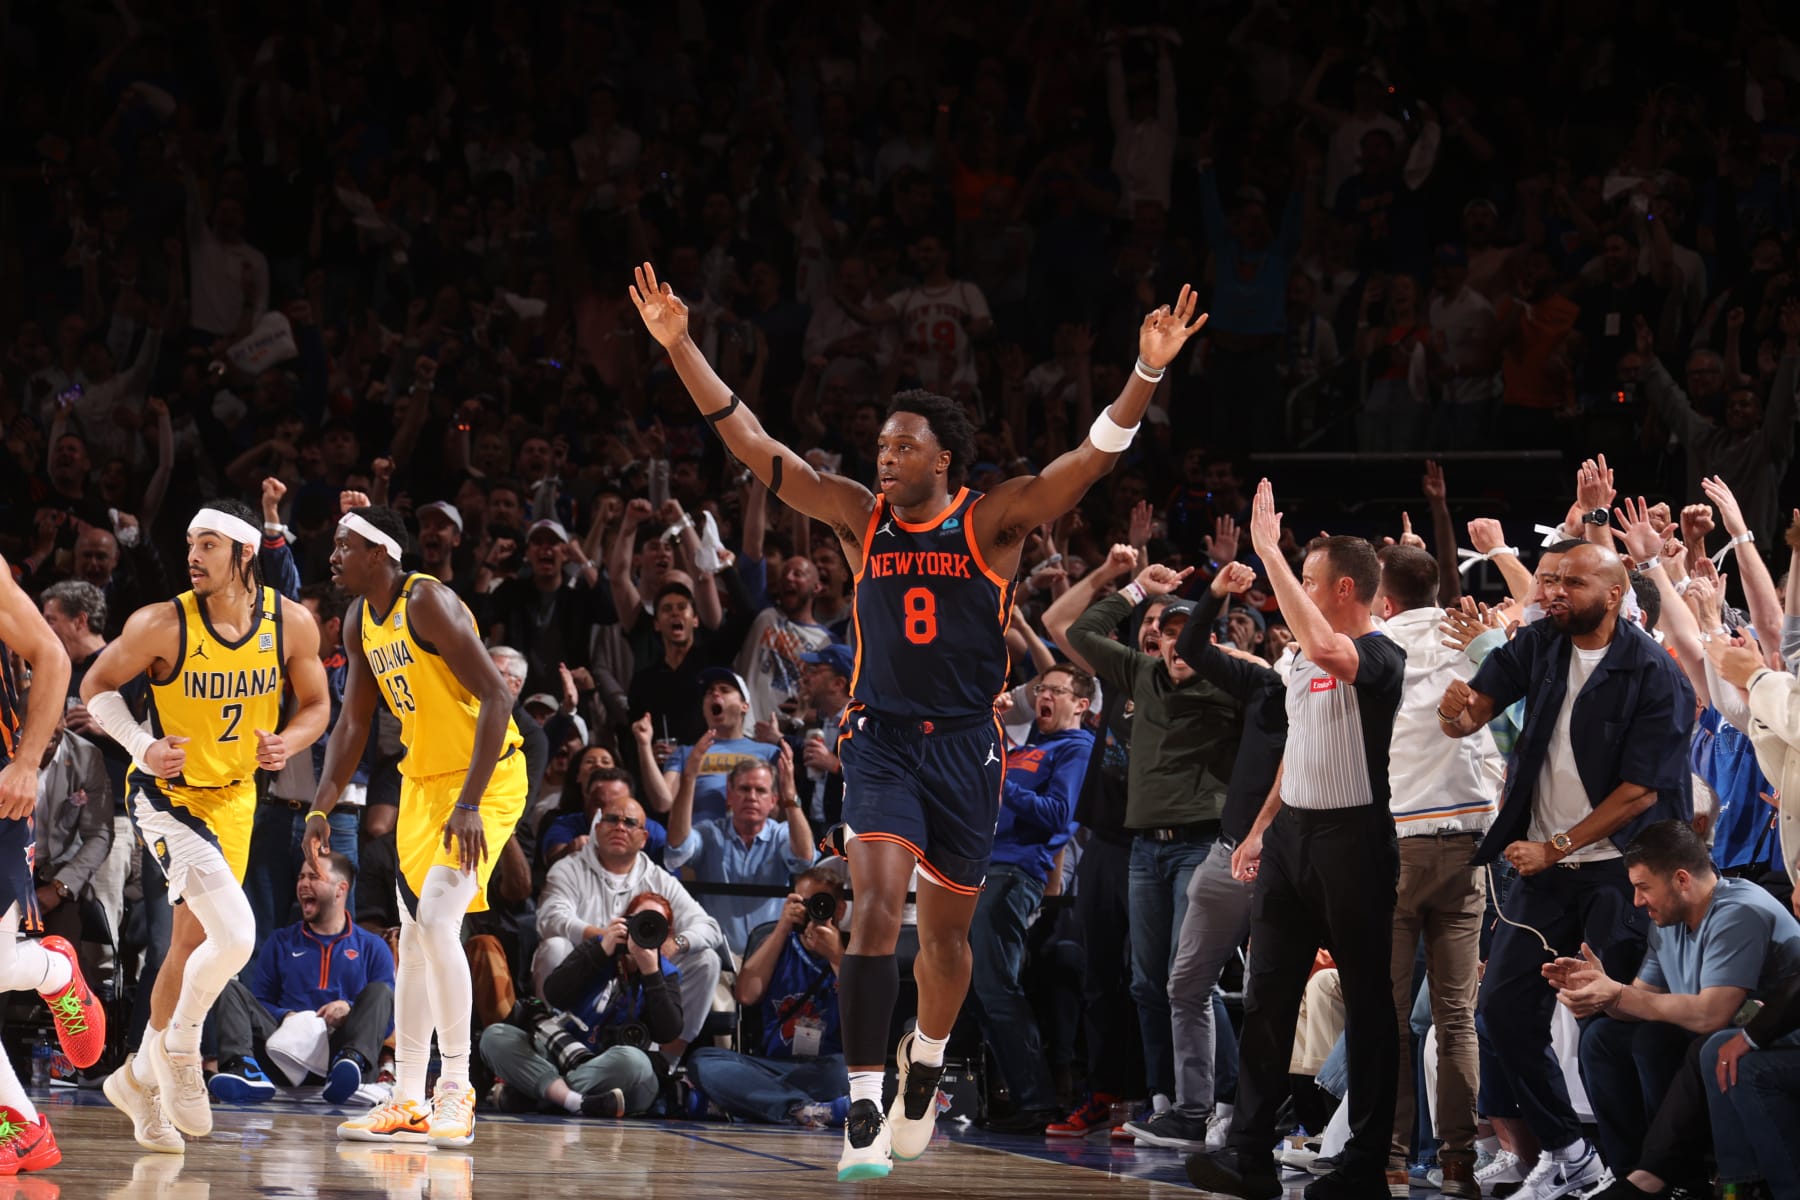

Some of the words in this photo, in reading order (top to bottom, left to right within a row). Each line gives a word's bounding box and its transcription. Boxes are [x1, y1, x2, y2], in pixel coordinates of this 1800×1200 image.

[917, 321, 956, 353] 19
[903, 586, 937, 645] 8
[184, 666, 277, 699] INDIANA
[385, 674, 416, 715] 43
[217, 703, 243, 742] 2
